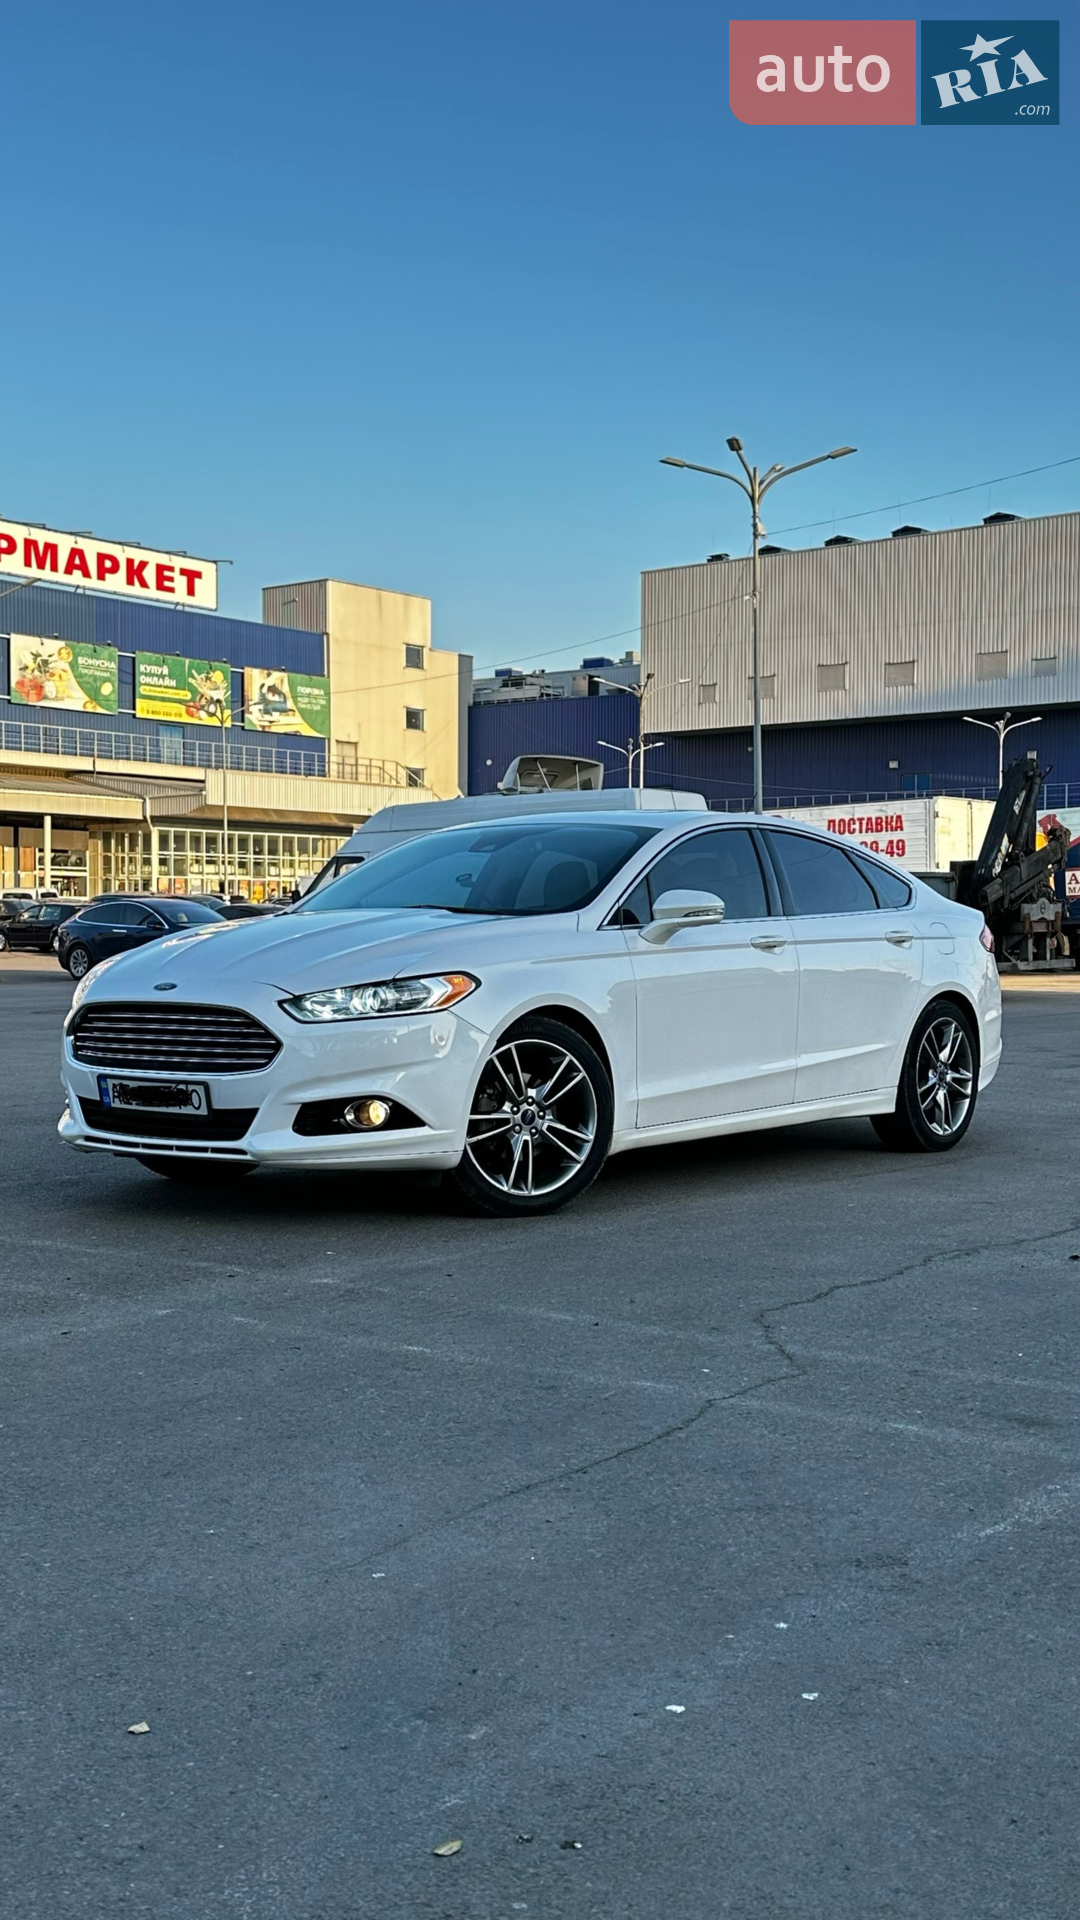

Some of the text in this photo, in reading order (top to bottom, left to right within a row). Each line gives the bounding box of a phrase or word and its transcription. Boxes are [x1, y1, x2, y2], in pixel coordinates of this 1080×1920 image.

[0, 532, 203, 597] РМАРКЕТ
[78, 656, 116, 669] БОНУСНА
[140, 664, 169, 676] КУПУЙ
[140, 675, 177, 688] ОНЛАЙН
[827, 814, 904, 835] ДОСТАВКА
